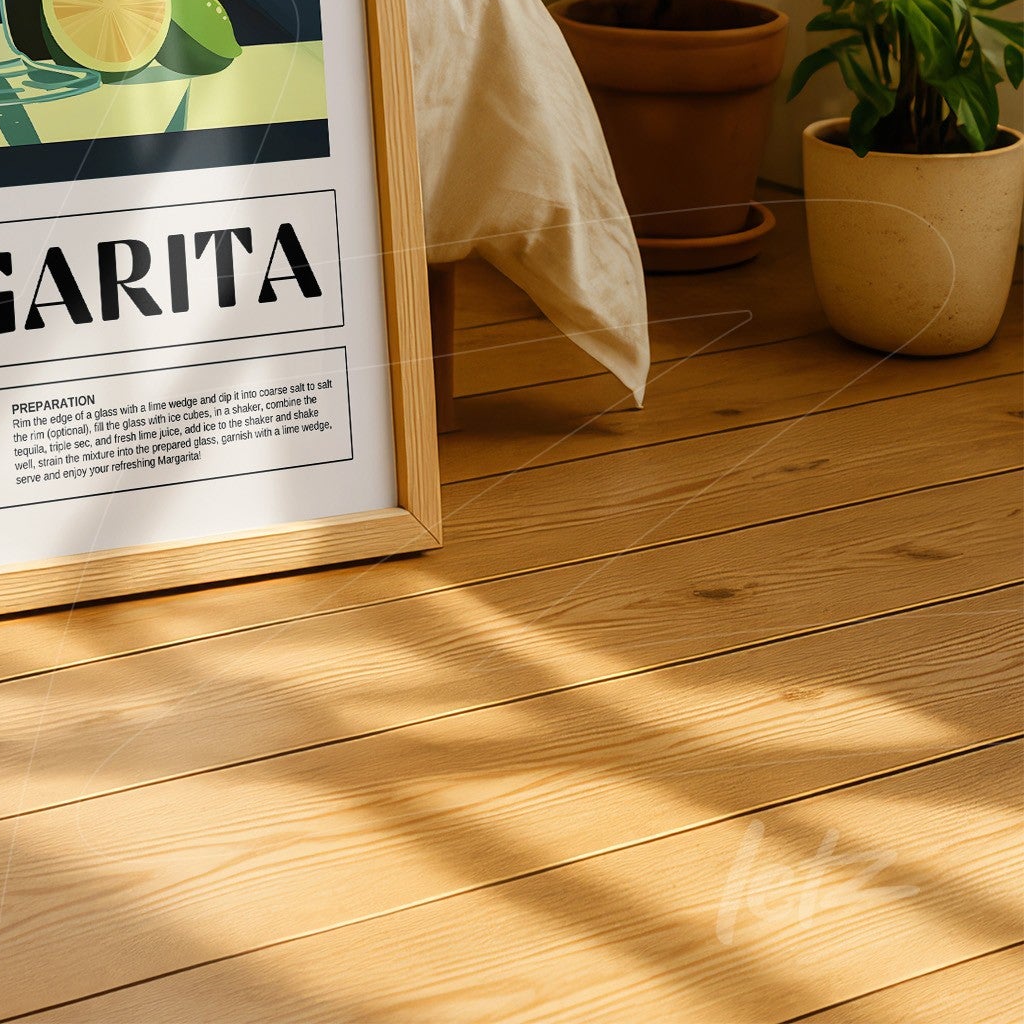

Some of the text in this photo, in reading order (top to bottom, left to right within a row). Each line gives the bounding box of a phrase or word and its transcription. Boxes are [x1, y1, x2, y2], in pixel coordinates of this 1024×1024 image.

[11, 394, 95, 415] PREPARATION
[12, 379, 333, 429] Rim the edge of a glass with a lime wedge and dip it into coarse salt to salt
[13, 432, 28, 443] the
[30, 430, 45, 440] rim
[47, 424, 91, 440] (optional),
[94, 421, 104, 432] fill
[106, 420, 120, 431] the
[122, 418, 146, 431] glass
[149, 414, 166, 425] with
[168, 413, 181, 423] ice
[183, 410, 212, 421] cubes,
[214, 407, 222, 416] in
[232, 403, 264, 414] shaker,
[266, 398, 302, 410] combine
[303, 395, 317, 405] the
[13, 408, 319, 457] tequila, triple sec, and fresh lime juice, add ice to the shaker and shake
[14, 420, 332, 471] well, strain the mixture into the prepared glass, garnish with a lime wedge,
[16, 451, 202, 485] serve and enjoy your refreshing Margarita!
